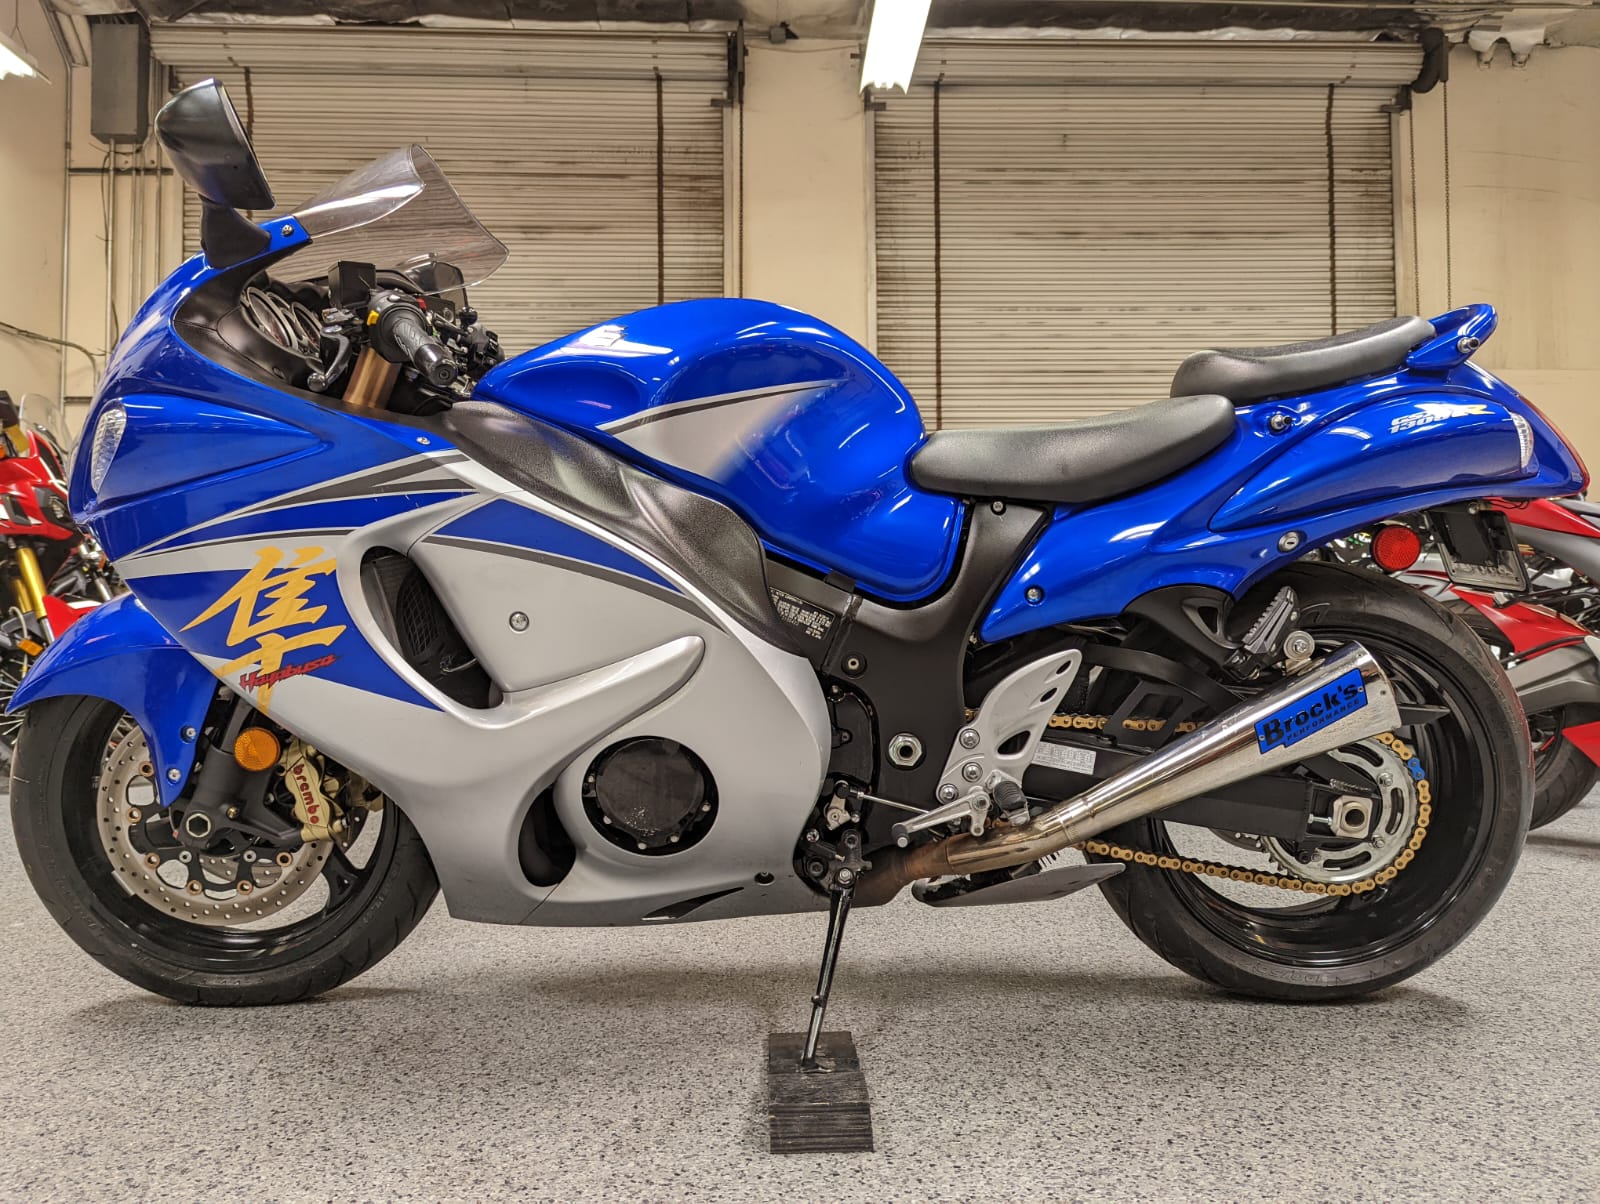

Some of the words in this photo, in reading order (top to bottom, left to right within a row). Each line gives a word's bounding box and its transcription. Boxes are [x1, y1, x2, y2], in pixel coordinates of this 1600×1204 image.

[178, 546, 347, 714] 隼
[239, 653, 340, 692] Hayabusa
[1263, 684, 1359, 746] Brock's
[293, 764, 320, 824] brembo
